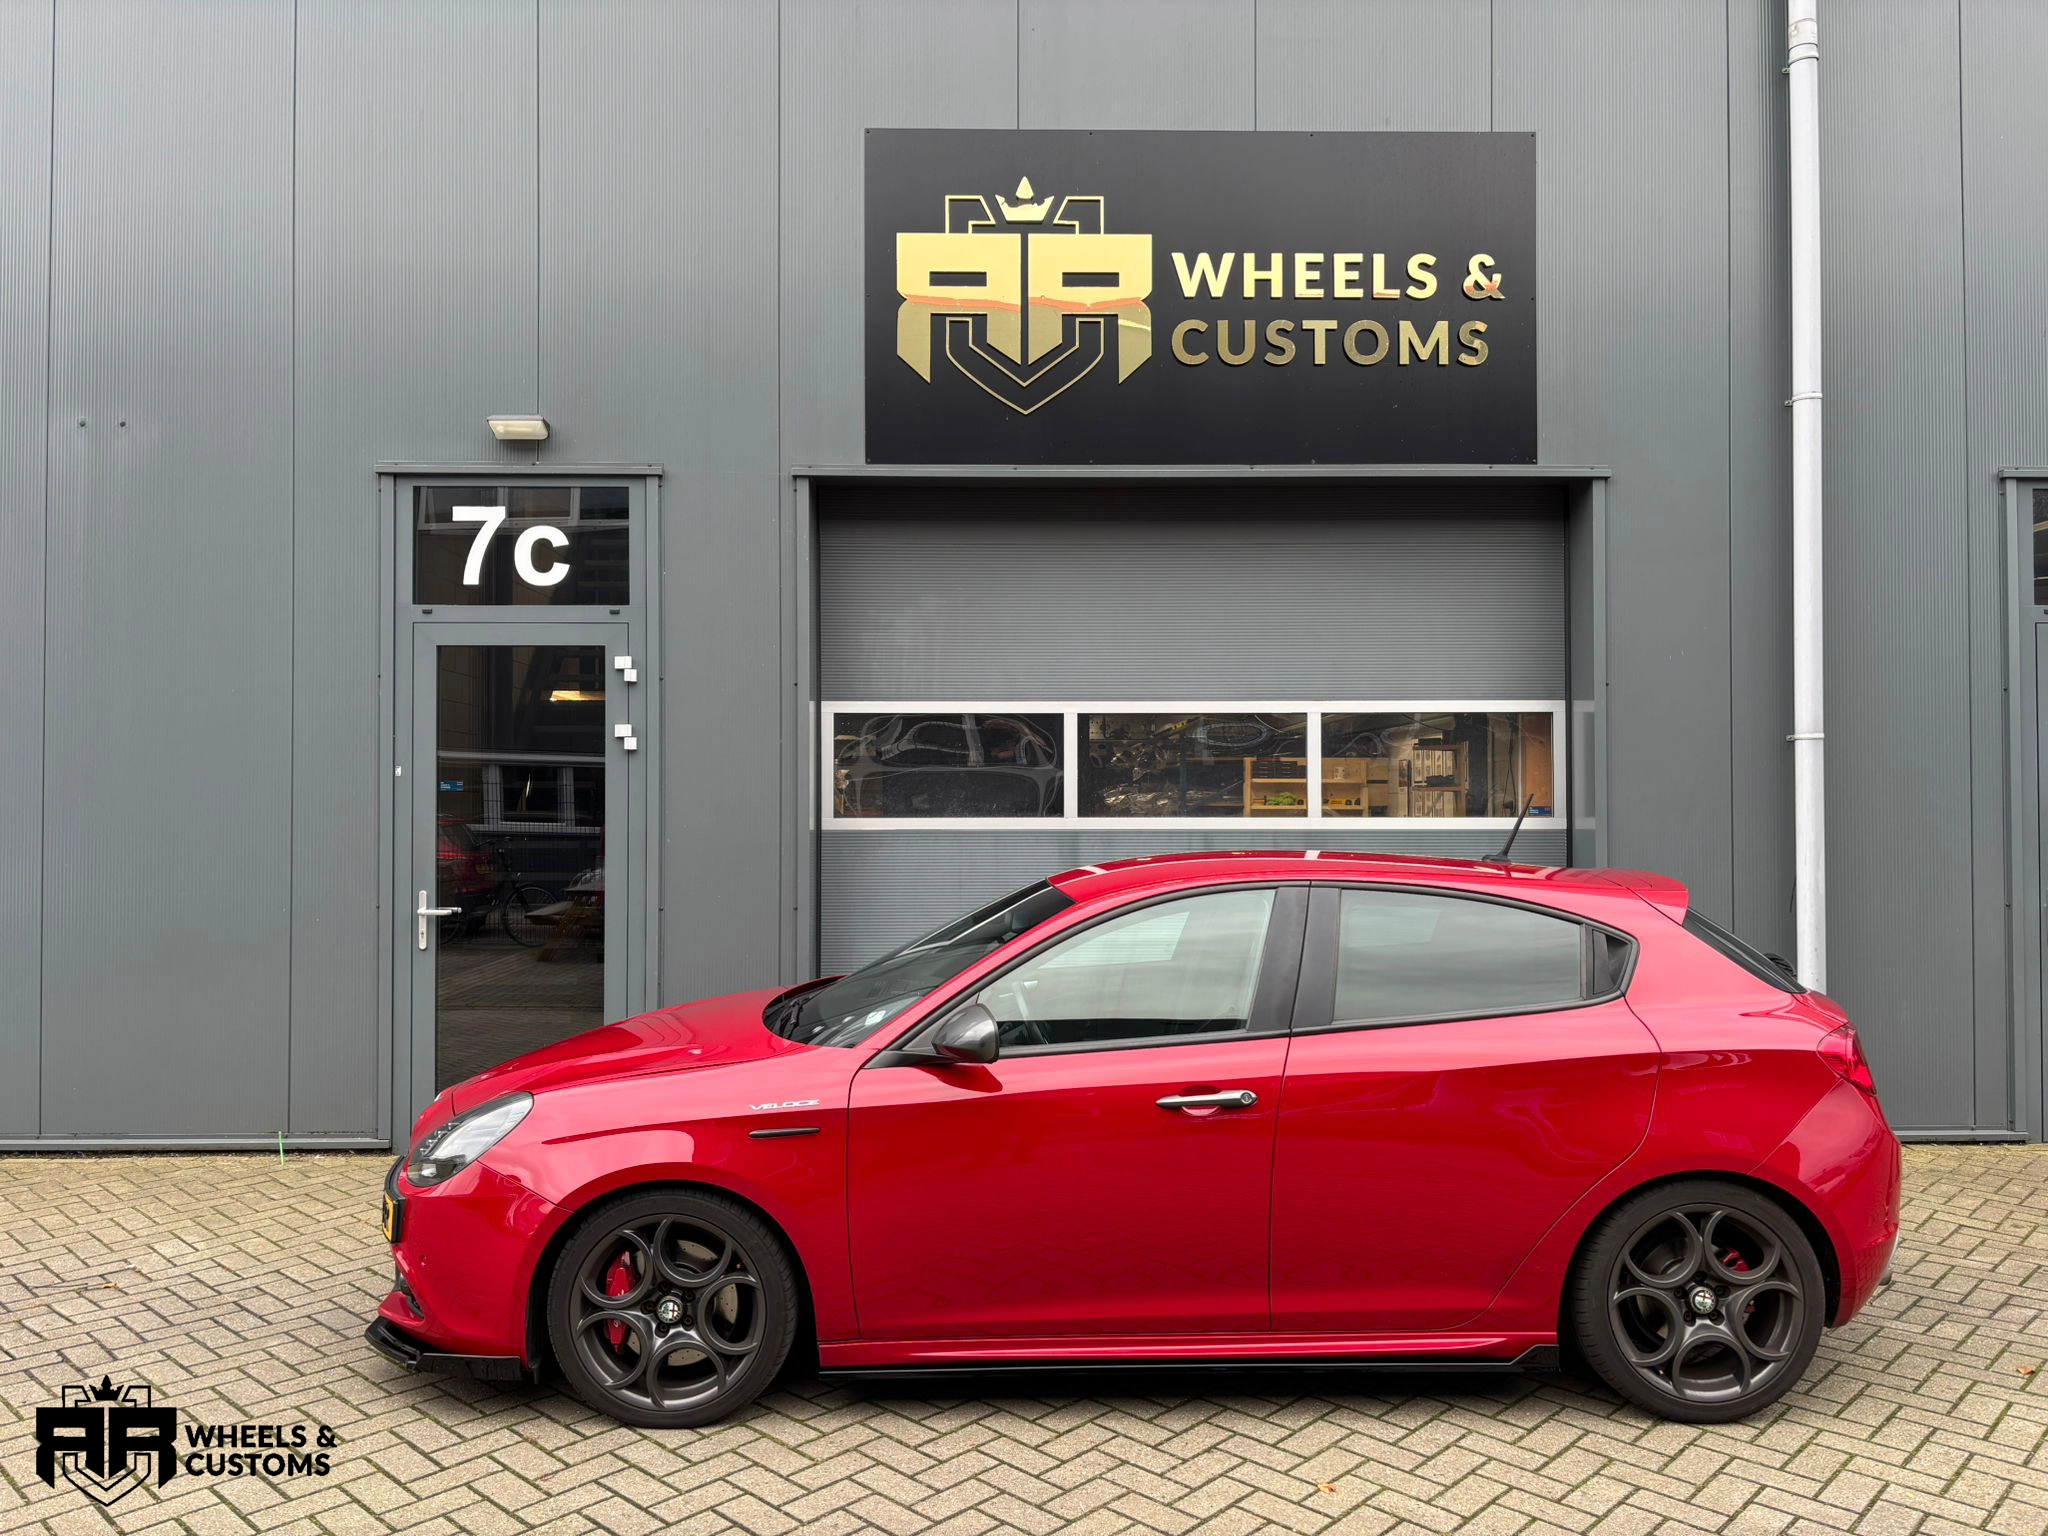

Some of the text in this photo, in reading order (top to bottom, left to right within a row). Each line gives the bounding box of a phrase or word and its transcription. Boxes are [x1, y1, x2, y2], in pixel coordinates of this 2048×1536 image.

[1171, 252, 1507, 300] WHEELS &
[1171, 319, 1489, 367] CUSTOMS
[749, 1099, 820, 1111] VELOCE
